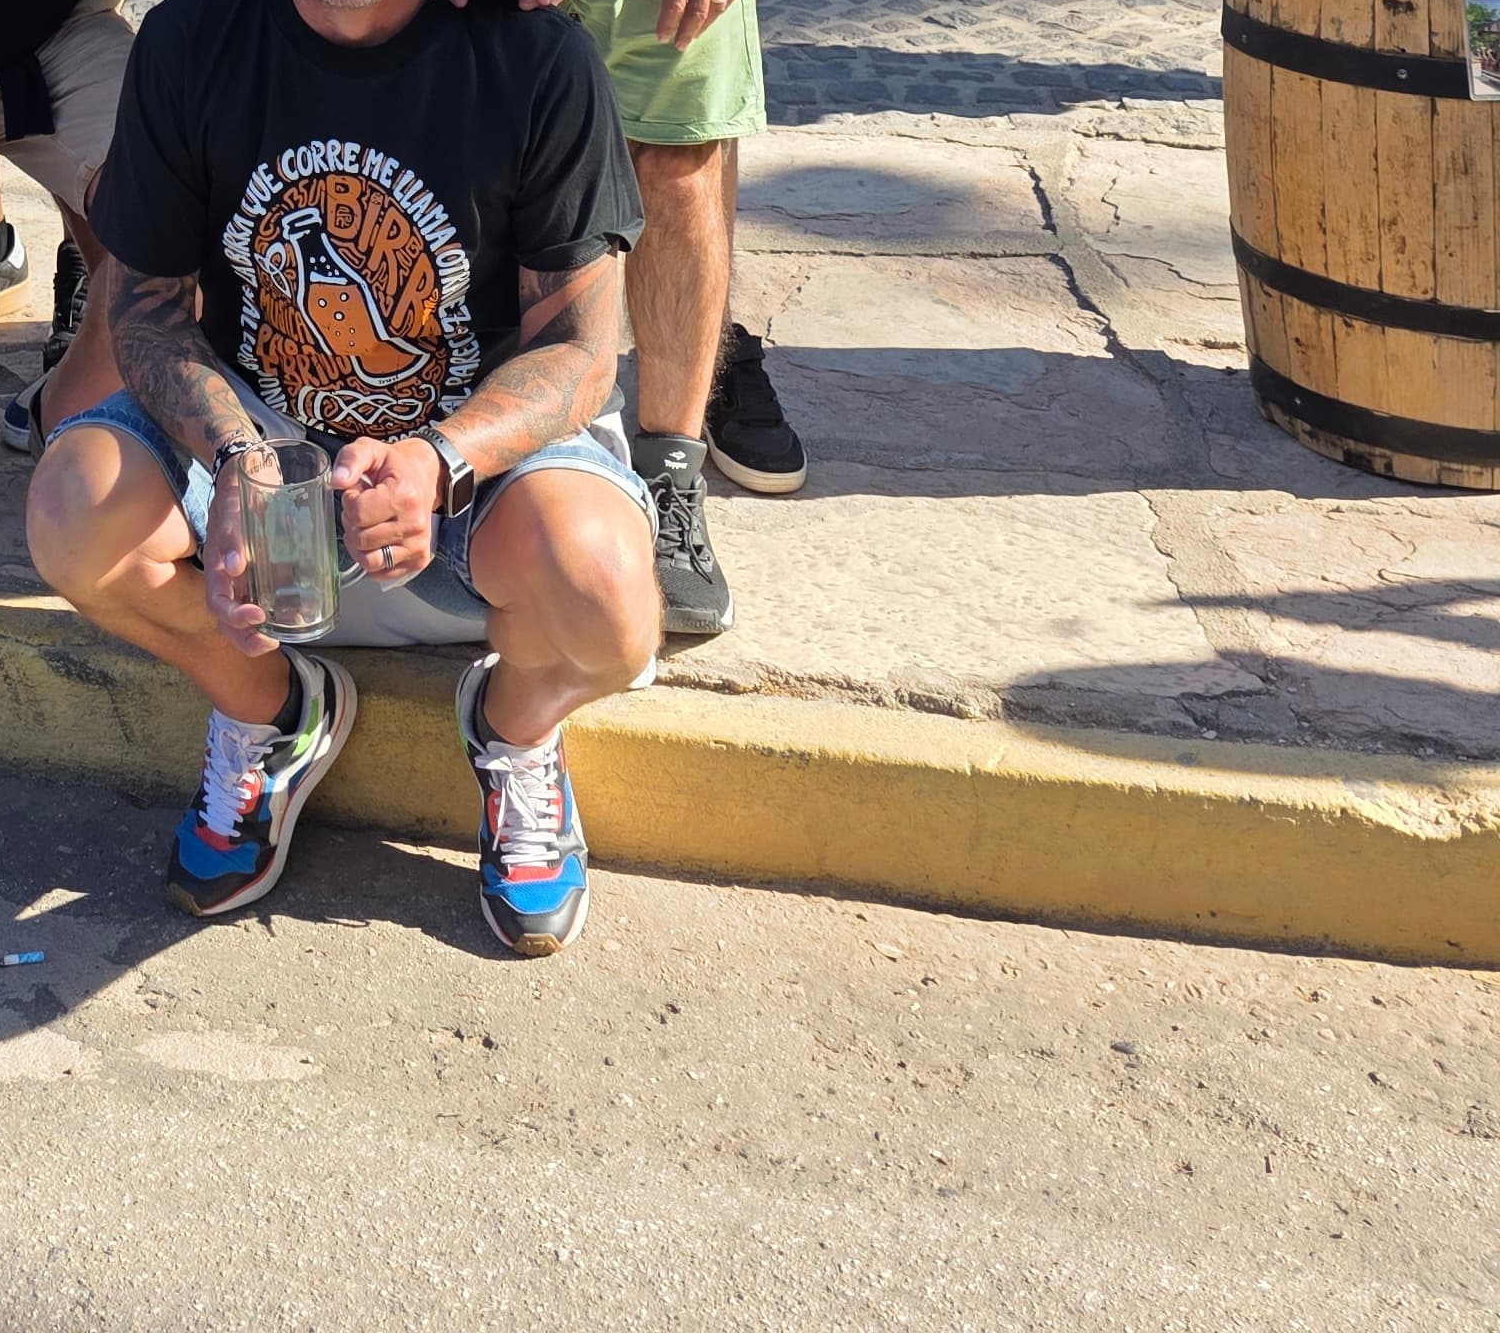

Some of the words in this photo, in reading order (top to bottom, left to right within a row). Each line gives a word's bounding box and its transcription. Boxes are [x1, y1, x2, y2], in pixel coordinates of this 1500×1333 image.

[241, 162, 284, 217] QUE
[281, 139, 361, 181] CORRE
[363, 148, 399, 185] ME
[391, 169, 458, 252] LLAMA
